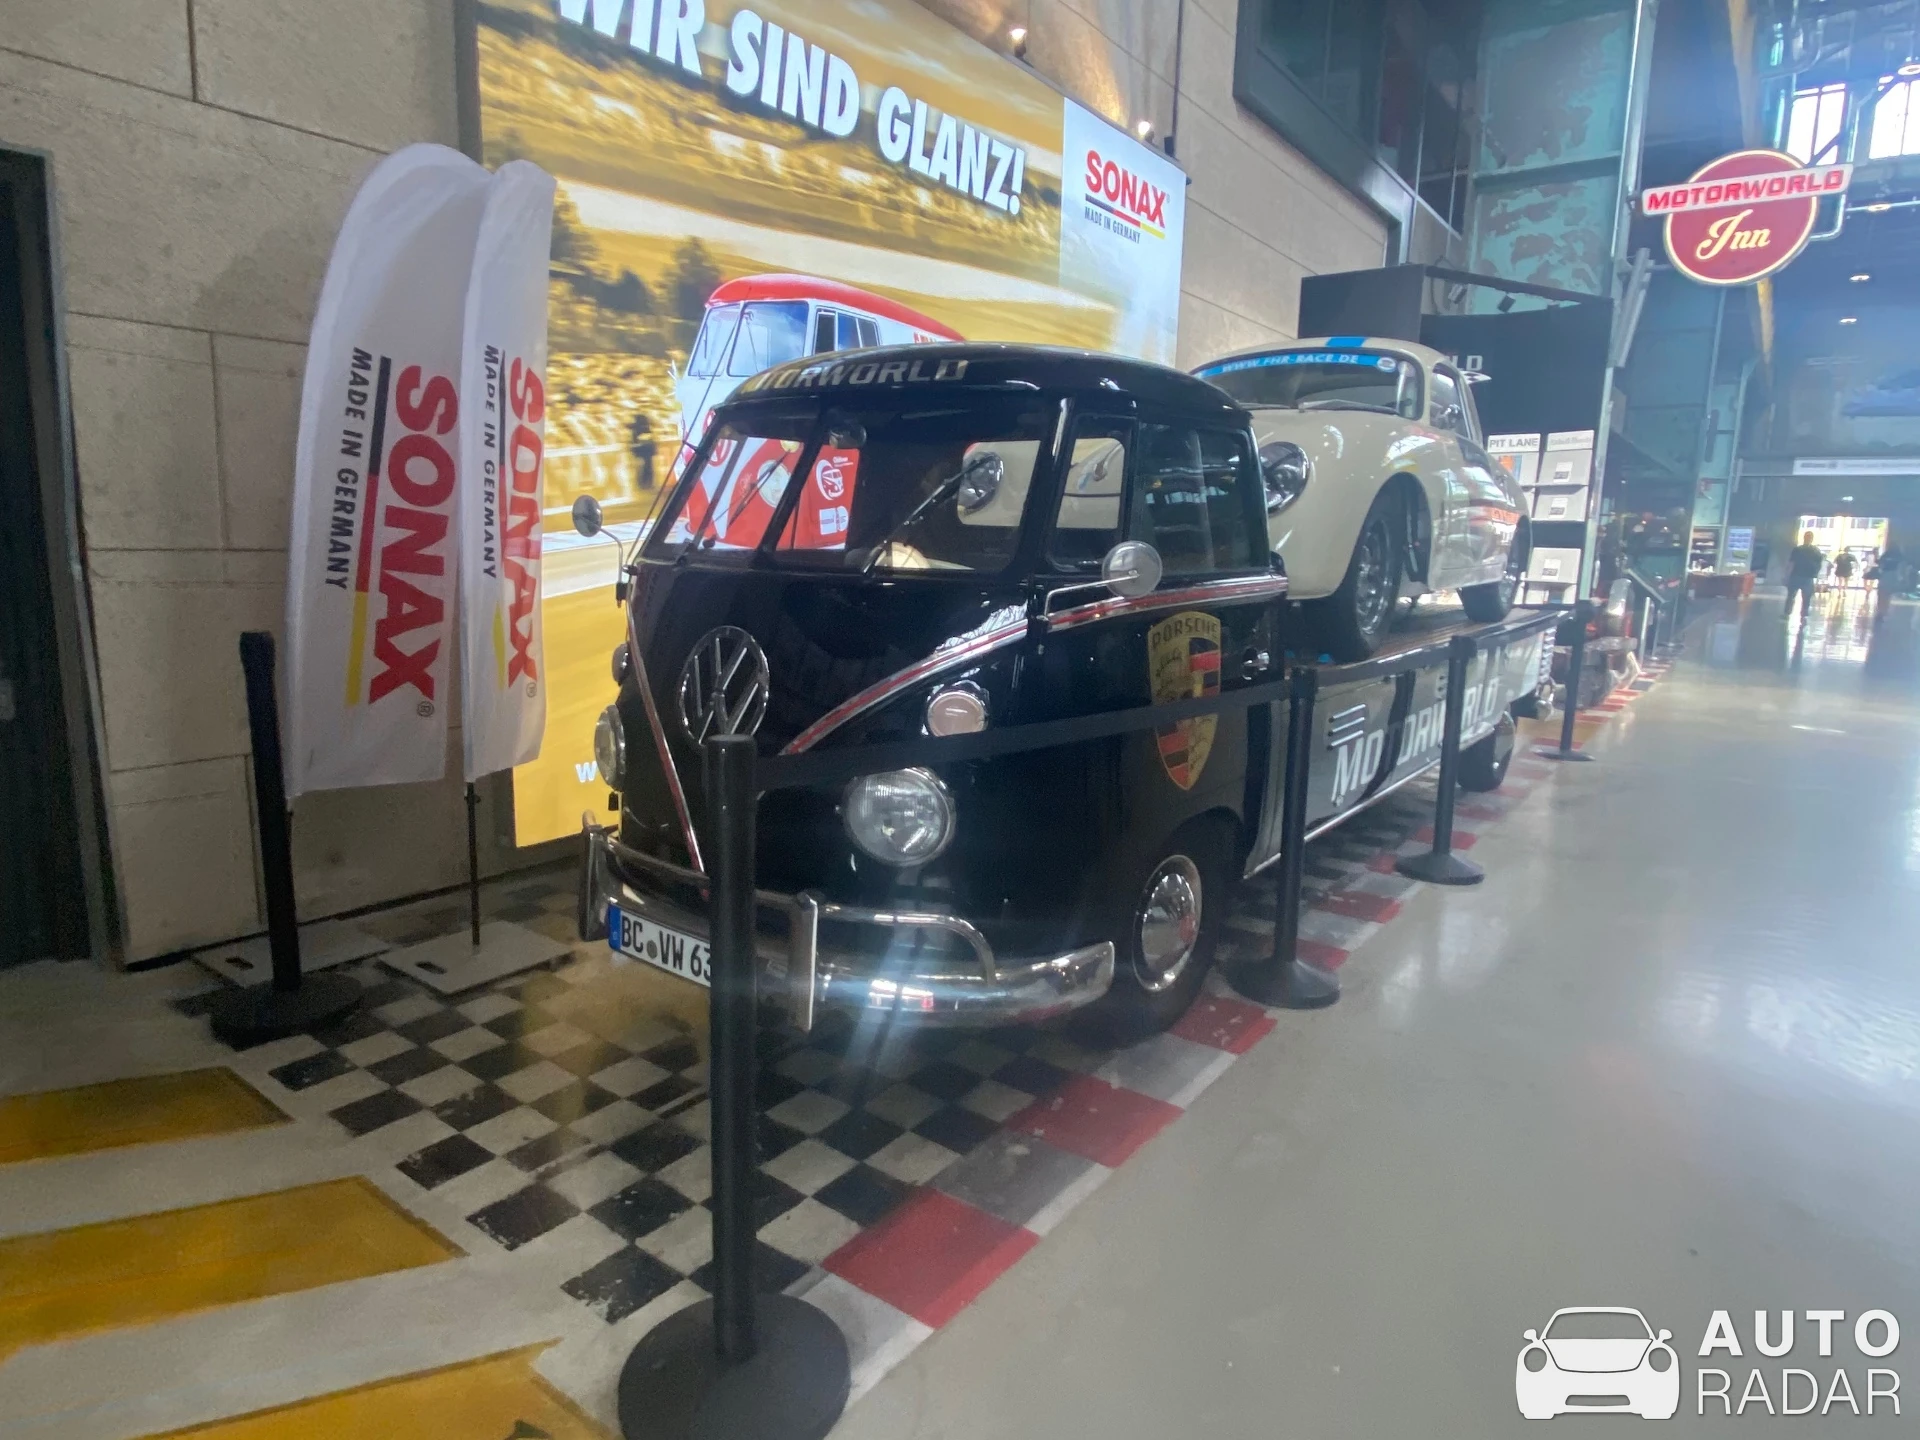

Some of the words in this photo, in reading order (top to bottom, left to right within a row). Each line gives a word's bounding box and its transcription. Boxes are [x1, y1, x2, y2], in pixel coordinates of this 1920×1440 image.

[726, 9, 860, 137] SIND
[877, 86, 1026, 215] GLANZ!
[1085, 149, 1167, 229] SONAX
[1647, 169, 1845, 211] MOTORWORLD
[1084, 206, 1102, 227] MADE
[1103, 215, 1112, 231] IN
[1112, 220, 1141, 245] GERMANY
[1696, 209, 1771, 260] Inn
[344, 347, 373, 421] MADE
[484, 344, 500, 414] MADE
[341, 430, 361, 457] IN
[484, 422, 496, 448] IN
[1489, 438, 1508, 448] PIT
[1509, 437, 1540, 447] LANE
[325, 467, 359, 590] GERMANY
[368, 364, 458, 705] SONAX
[483, 459, 498, 579] GERMANY
[504, 356, 546, 689] SONAX
[1151, 617, 1219, 650] PORSCHE
[621, 915, 644, 953] BC
[659, 930, 685, 971] VW
